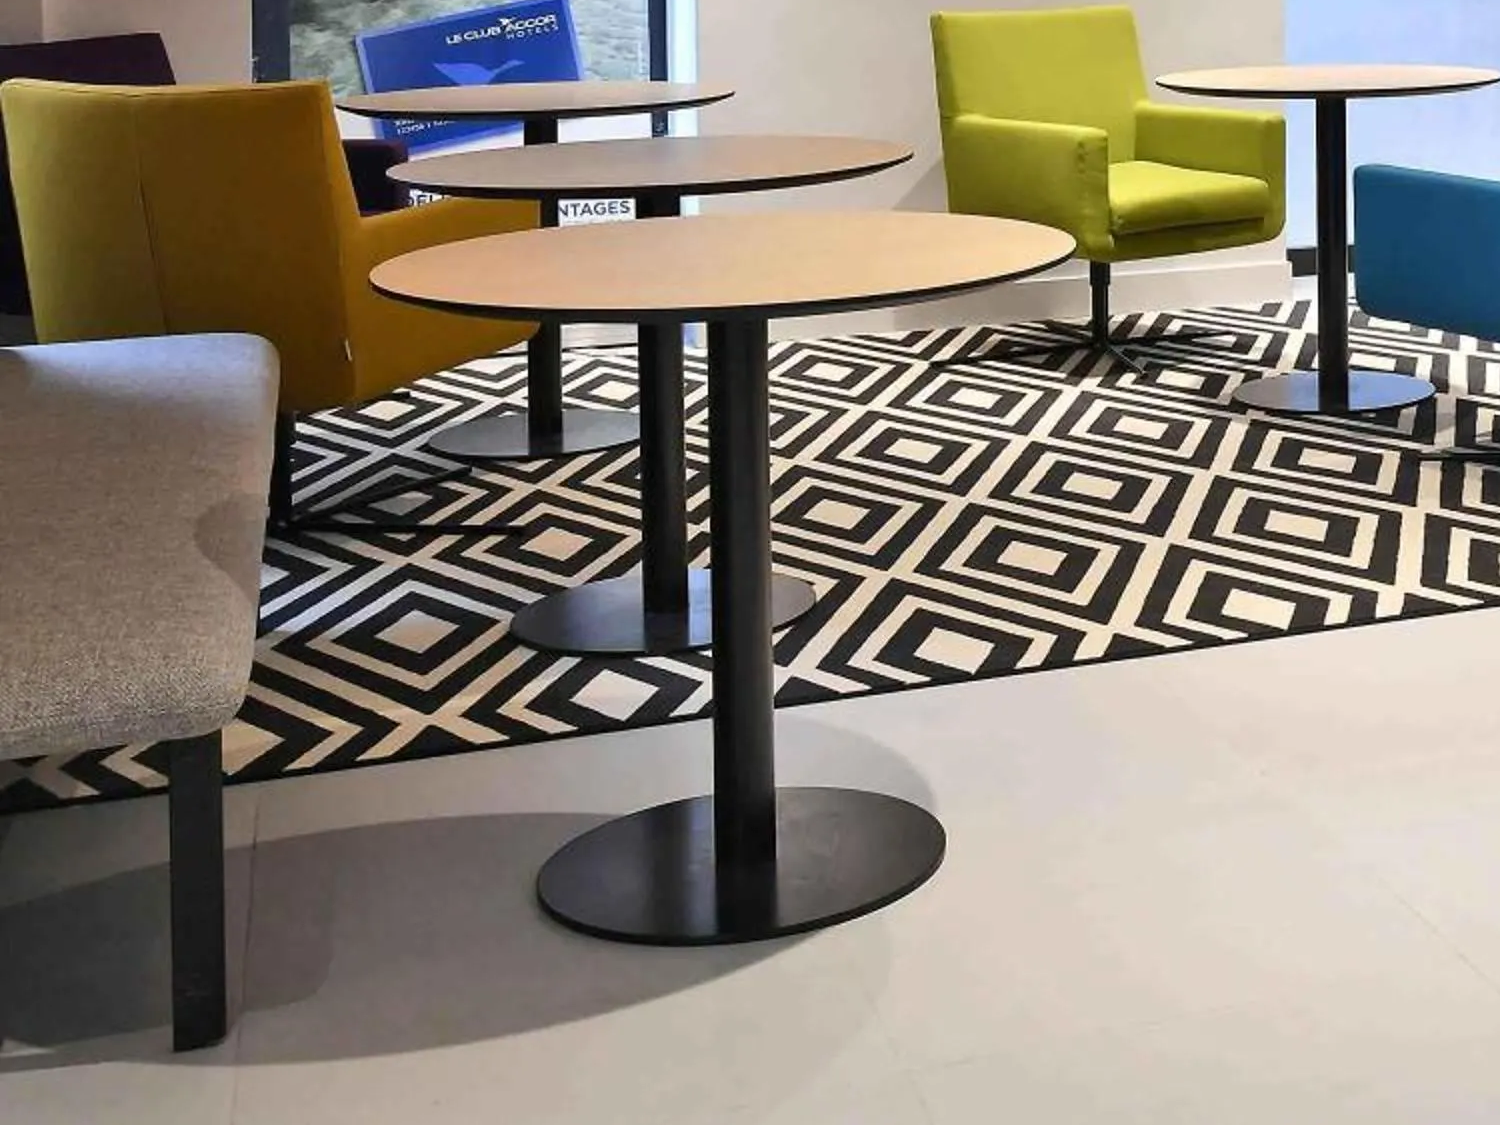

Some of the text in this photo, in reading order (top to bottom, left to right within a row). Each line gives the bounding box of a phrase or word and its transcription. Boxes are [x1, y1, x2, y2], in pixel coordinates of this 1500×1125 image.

[445, 14, 557, 45] LE CLUB ACCOR
[506, 25, 559, 40] HOTELS
